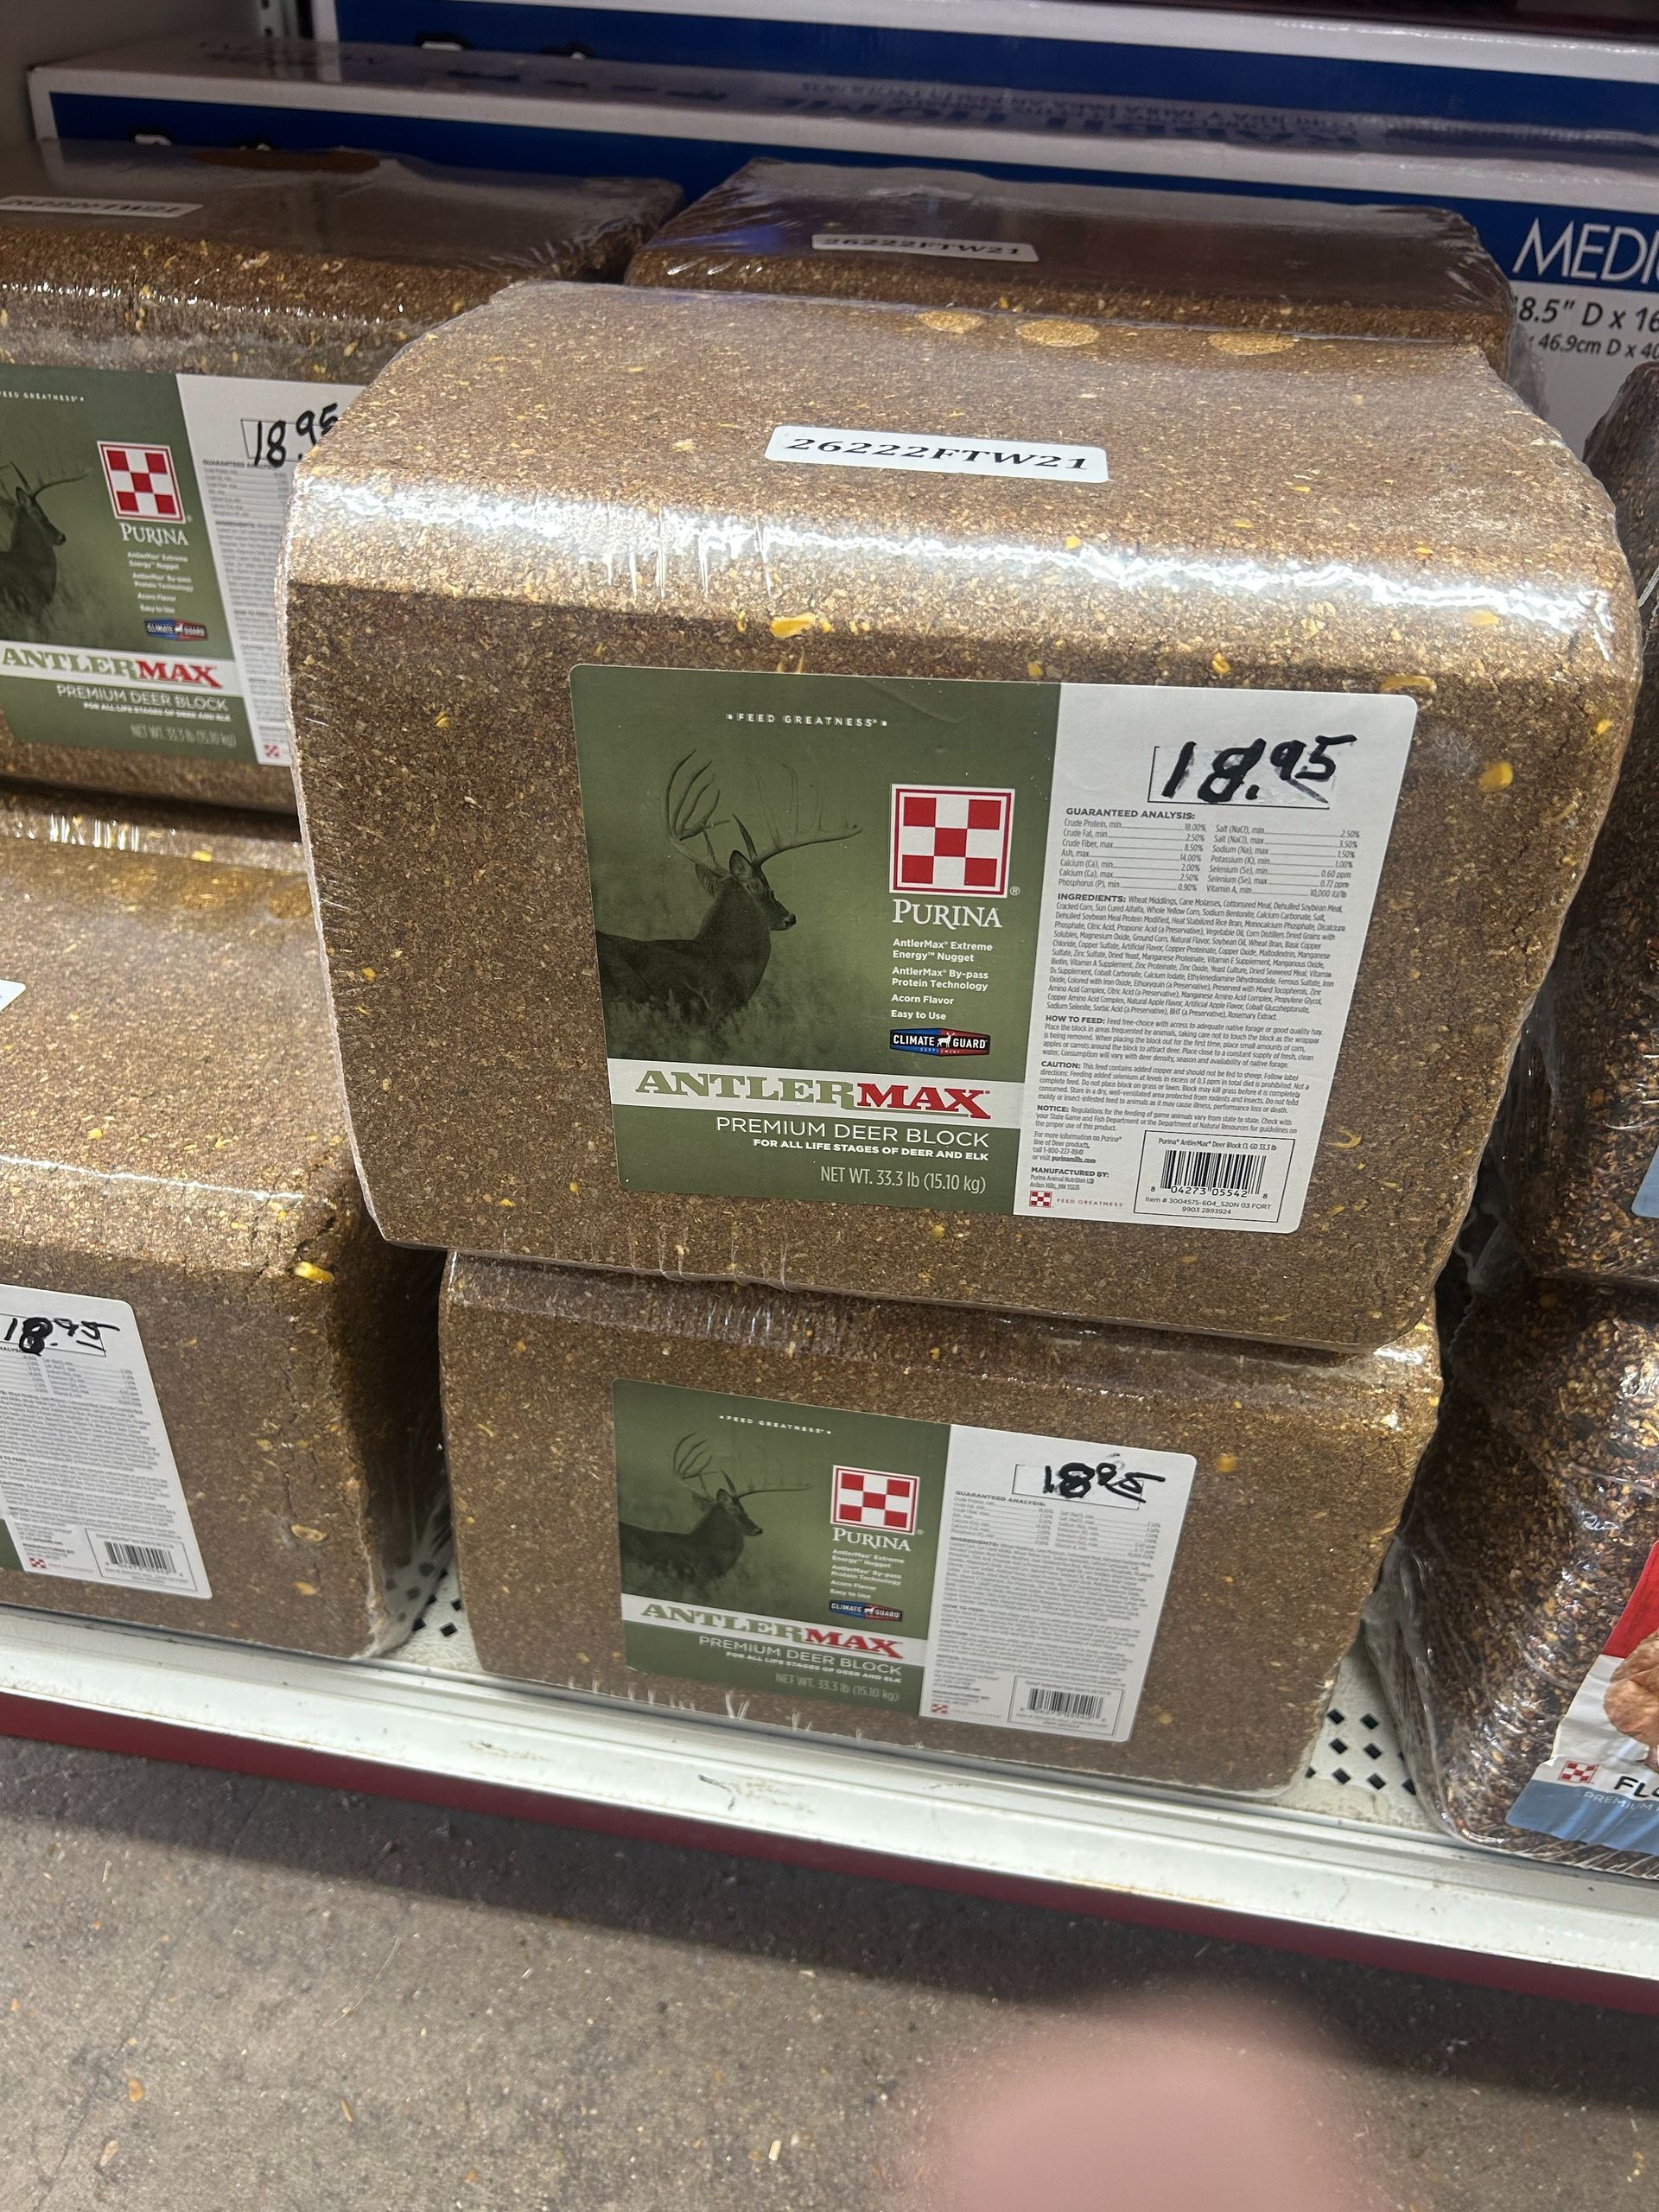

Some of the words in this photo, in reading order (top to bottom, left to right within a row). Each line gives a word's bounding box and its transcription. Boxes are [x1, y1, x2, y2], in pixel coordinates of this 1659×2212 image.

[823, 237, 1019, 255] 26222FTW21
[1512, 218, 1659, 284] MEDI
[1513, 296, 1575, 323] 8.5"
[1582, 303, 1603, 327] D
[1609, 311, 1626, 329] x
[785, 437, 1087, 470] 26222FTW21
[119, 523, 189, 546] PURINA
[2, 647, 223, 690] ANTLERMAX
[56, 683, 127, 702] PREMIUM
[130, 691, 172, 707] DEER
[175, 696, 228, 711] BLOCK
[738, 713, 775, 723] FEED
[1161, 734, 1357, 804] 18.95
[1066, 807, 1138, 817] GUARANTEED
[1141, 810, 1195, 820] ANALYSIS:
[1065, 818, 1082, 827] Crude
[1084, 819, 1108, 829] Protein,
[1185, 823, 1206, 831] 18.00%
[1229, 825, 1250, 835] (NaCl),
[1082, 830, 1094, 838] Fat,
[1185, 833, 1205, 842] 2.50%
[1227, 836, 1249, 844] (NaCl),
[1339, 840, 1357, 849] 3.50%
[1063, 838, 1080, 847] Crude
[1082, 840, 1098, 849] Fiber,
[1185, 843, 1203, 852] 8.50%
[1237, 846, 1253, 855] (Na),
[1061, 849, 1074, 857] Ash,
[1085, 860, 1099, 868] (Ca),
[1059, 868, 1083, 877] Calcium
[1084, 869, 1098, 879] (Ca),
[1058, 879, 1093, 887] Phosphorus
[1095, 880, 1106, 888] (P),
[1178, 883, 1197, 892] 0.90%
[1058, 893, 1126, 903] INGREDIENTS:
[893, 899, 1002, 930] PURINA
[950, 942, 992, 951] Extreme
[937, 952, 974, 963] Nugget
[949, 969, 988, 980] By-pass
[892, 978, 928, 988] Protein
[930, 980, 988, 992] Technology
[892, 995, 921, 1003] Acorn
[923, 995, 954, 1005] Flavor
[891, 1010, 912, 1021] Easy
[915, 1011, 926, 1020] to
[929, 1012, 946, 1020] Use
[893, 1034, 935, 1047] CLIMATE
[952, 1038, 986, 1050] GUARD
[635, 1070, 990, 1119] ANTLERMAX
[716, 1116, 826, 1138] PREMIUM
[835, 1123, 898, 1142] DEER
[906, 1128, 990, 1147] BLOCK
[753, 1138, 778, 1147] FOR
[780, 1140, 803, 1149] ALL
[805, 1141, 831, 1151] LIFE
[833, 1143, 880, 1154] STAGES
[881, 1146, 899, 1155] OF
[901, 1147, 933, 1158] DEER
[936, 1149, 963, 1160] AND
[965, 1151, 989, 1161] ELK
[1032, 1166, 1095, 1177] MANUFACTURED
[821, 1167, 845, 1183] NET
[849, 1167, 873, 1185] WT.
[876, 1170, 904, 1187] 33.3
[906, 1171, 919, 1188] lb
[923, 1172, 959, 1192] (15.10
[963, 1173, 986, 1194] kg)
[1170, 1185, 1205, 1195] 04273
[1211, 1188, 1248, 1198] 05542
[832, 1528, 911, 1551] PURINA
[831, 1603, 862, 1613] CLIMATE
[875, 1609, 899, 1618] GUARD
[641, 1604, 903, 1659] ANTLERMAX
[699, 1636, 780, 1656] PREMIUM
[787, 1649, 833, 1665] DEER
[840, 1657, 903, 1675] BLOCK
